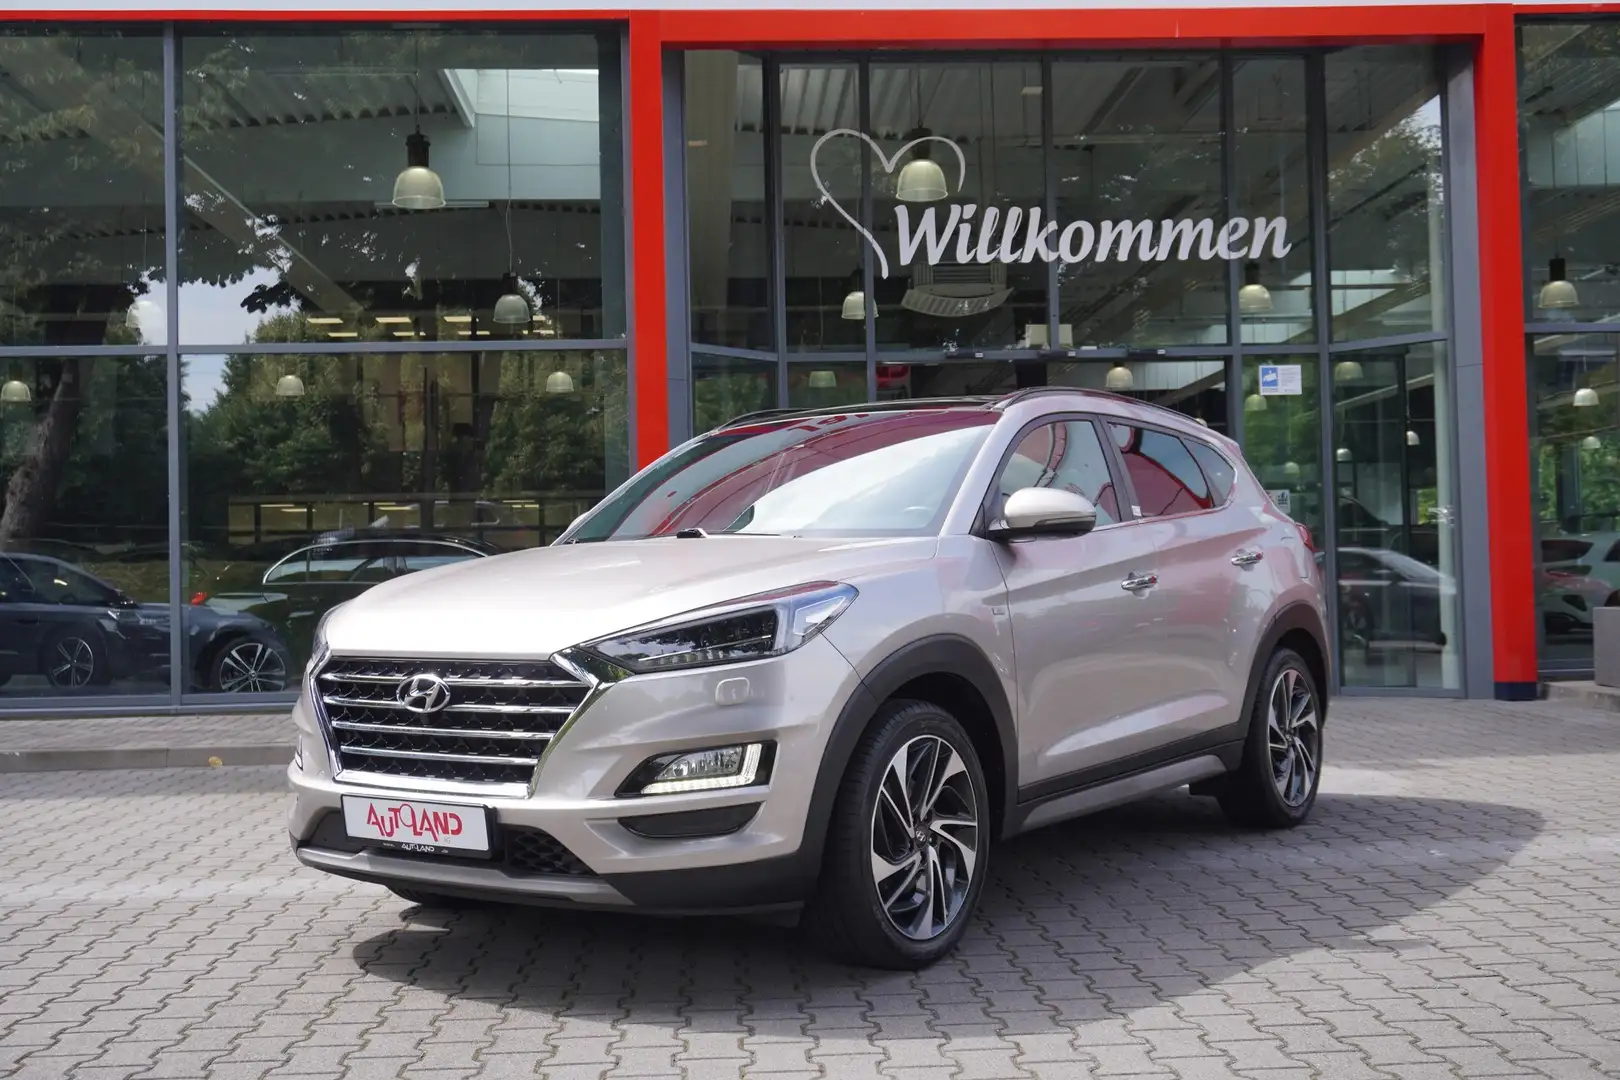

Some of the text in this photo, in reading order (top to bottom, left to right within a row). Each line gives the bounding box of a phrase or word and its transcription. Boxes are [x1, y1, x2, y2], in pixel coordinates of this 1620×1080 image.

[894, 203, 1292, 266] Willkommen
[367, 802, 463, 842] AUTOLAND
[401, 843, 435, 853] AUTOLAND
